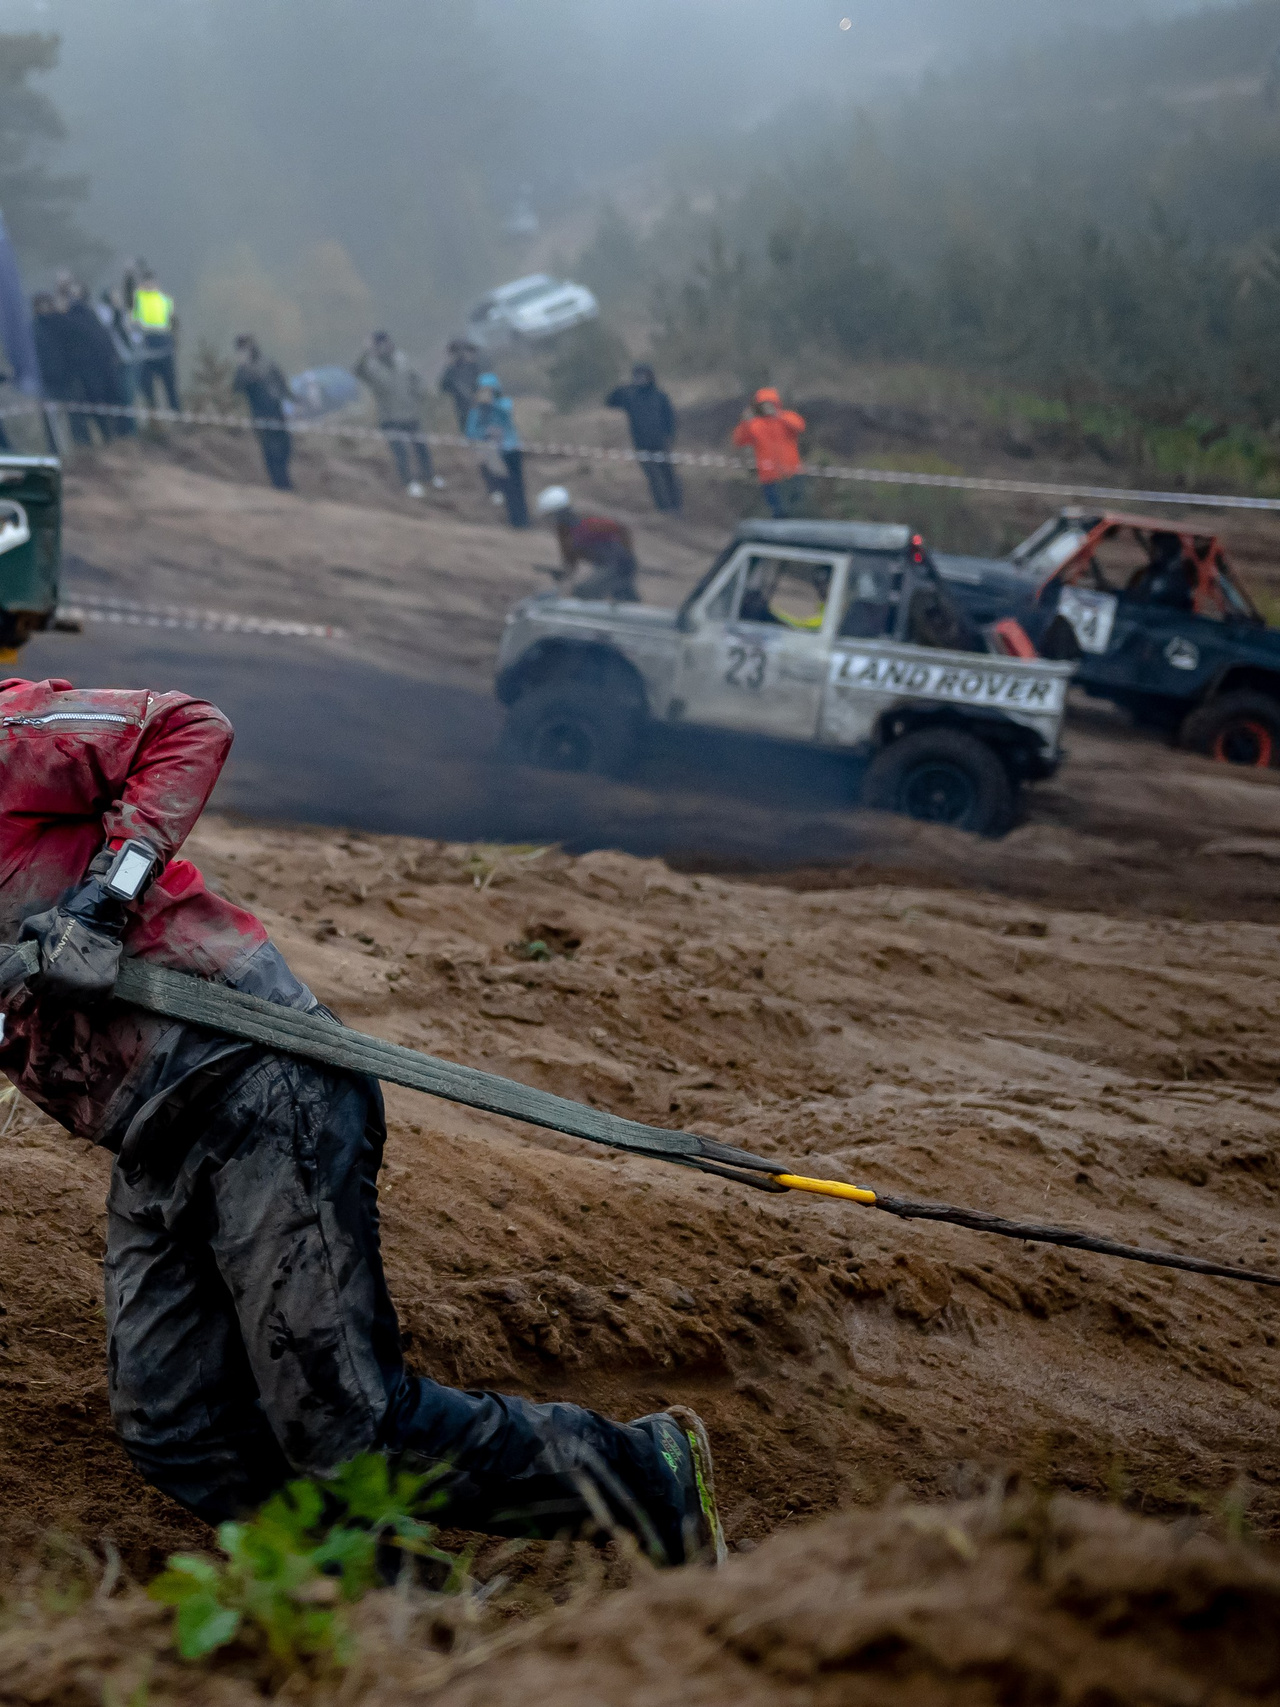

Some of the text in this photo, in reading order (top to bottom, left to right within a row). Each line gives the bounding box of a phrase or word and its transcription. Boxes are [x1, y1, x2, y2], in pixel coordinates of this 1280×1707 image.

[725, 646, 767, 689] 23
[837, 655, 1051, 701] LAND ROVER
[49, 919, 76, 963] FINNTRAIL
